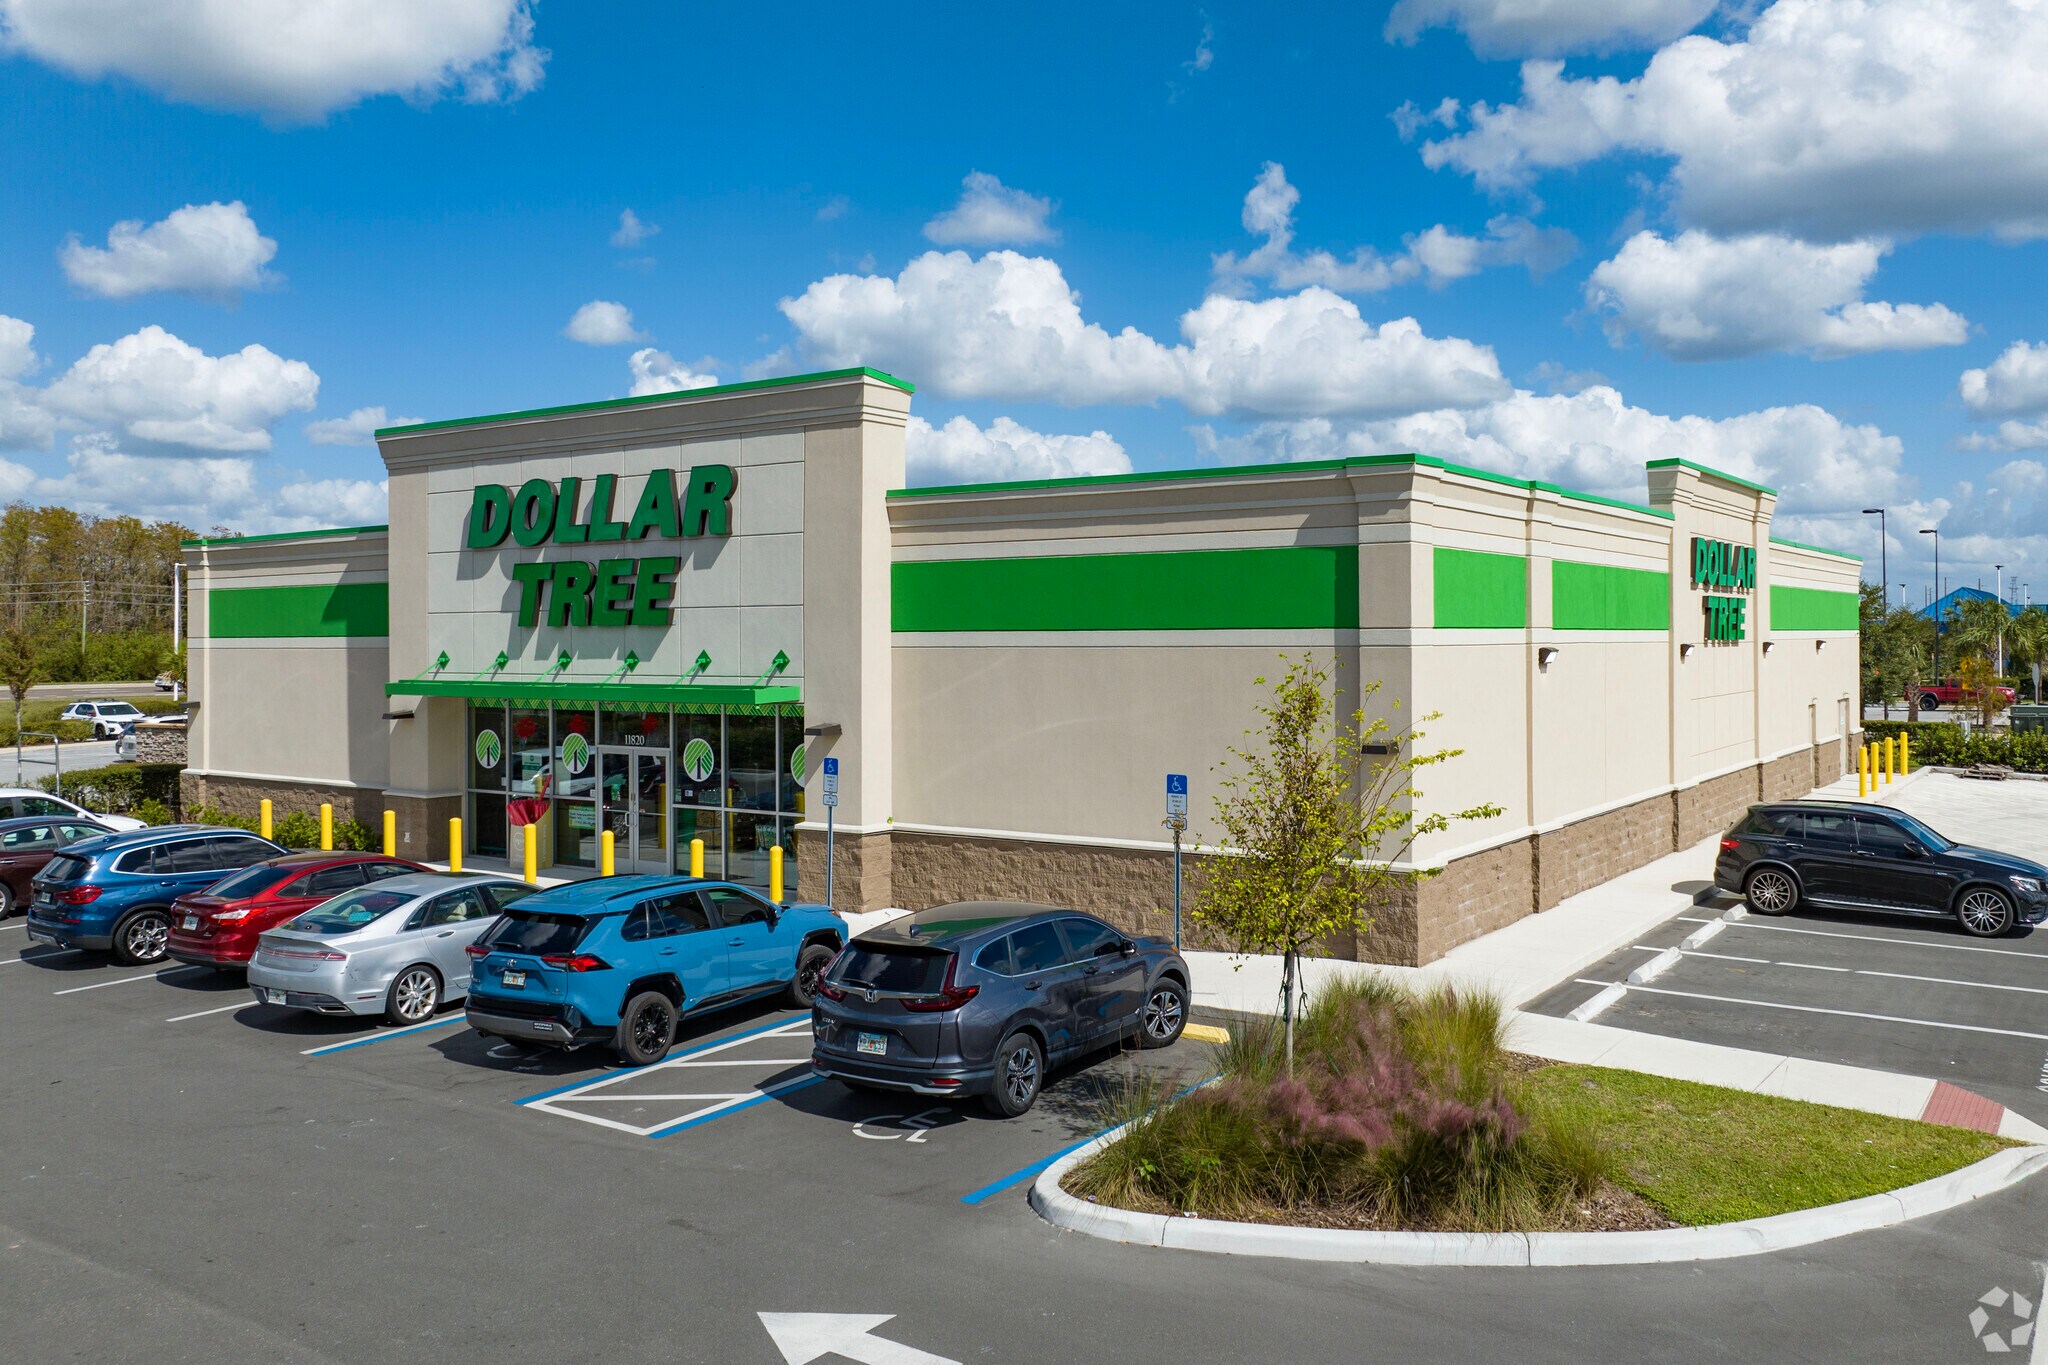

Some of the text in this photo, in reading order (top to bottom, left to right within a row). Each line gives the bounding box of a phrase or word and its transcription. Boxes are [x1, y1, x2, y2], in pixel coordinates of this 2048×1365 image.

[467, 464, 738, 548] DOLLAR
[1691, 537, 1757, 589] DOLLAR
[512, 556, 681, 627] TREE
[1702, 595, 1746, 640] TREE
[624, 734, 645, 746] 11820
